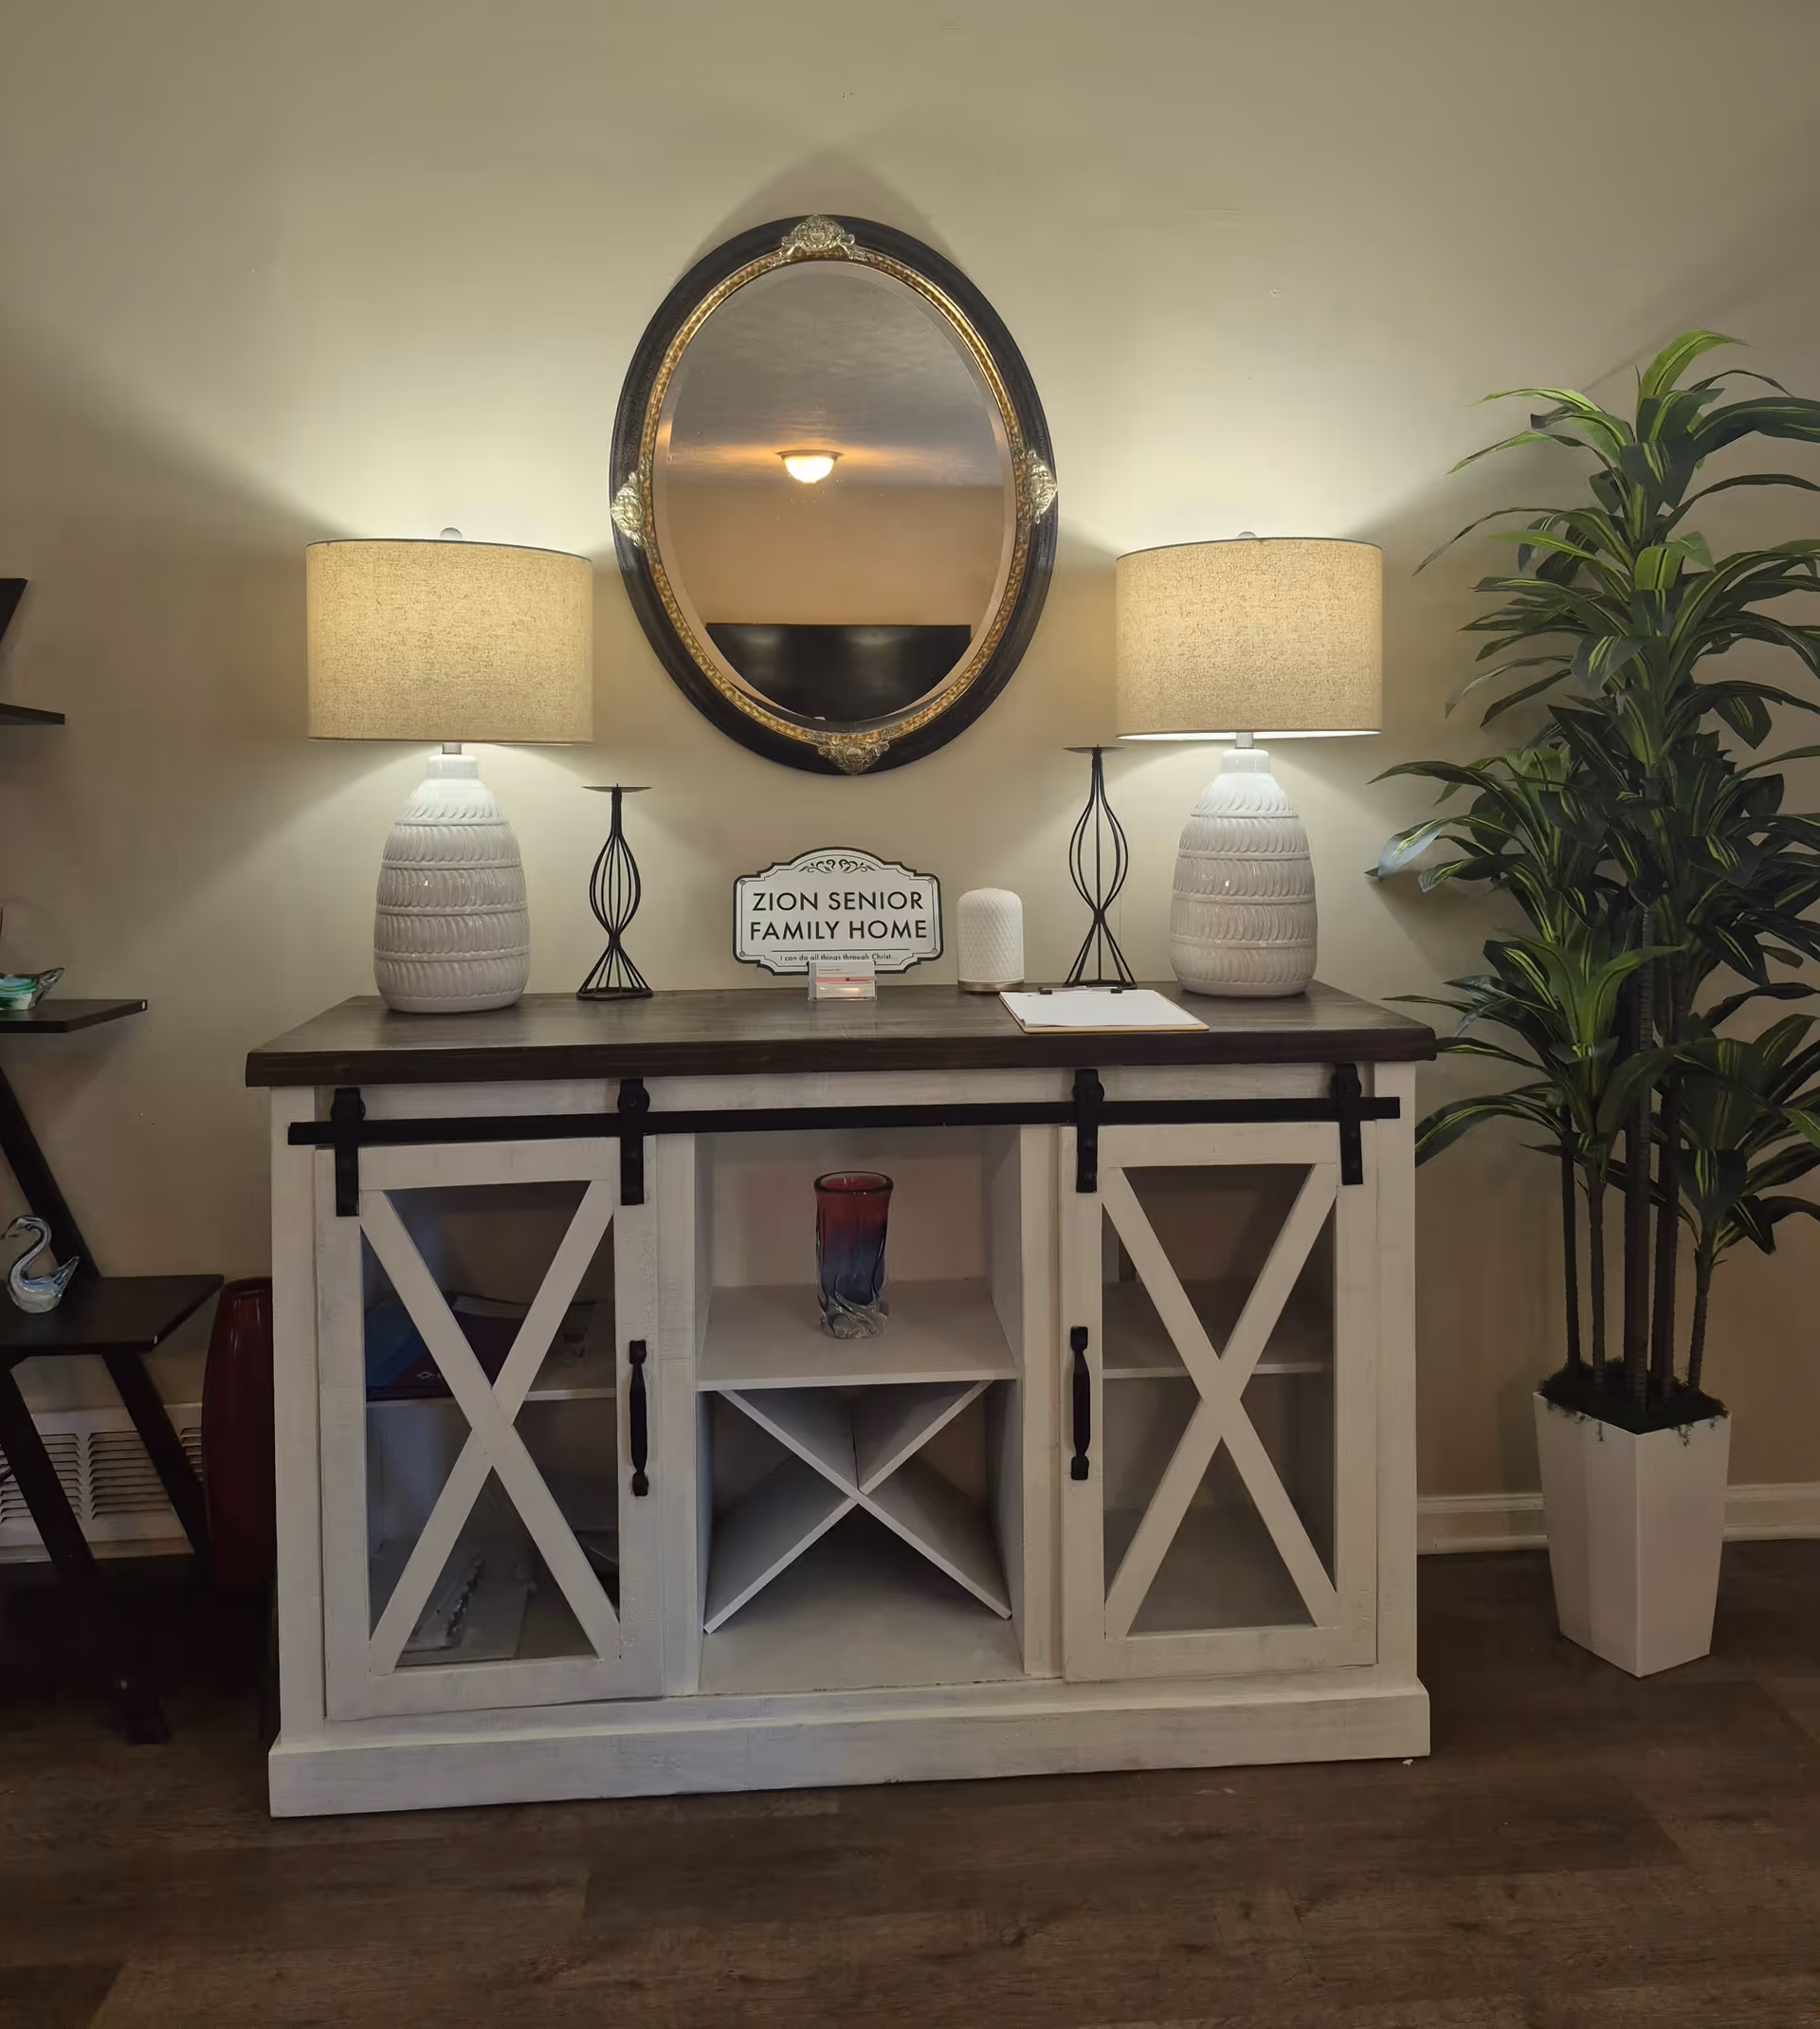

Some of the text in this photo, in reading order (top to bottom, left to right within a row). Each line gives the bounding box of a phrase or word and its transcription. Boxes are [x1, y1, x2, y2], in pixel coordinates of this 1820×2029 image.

[752, 891, 923, 911] ZION SENIOR
[750, 920, 927, 941] FAMILY HOME
